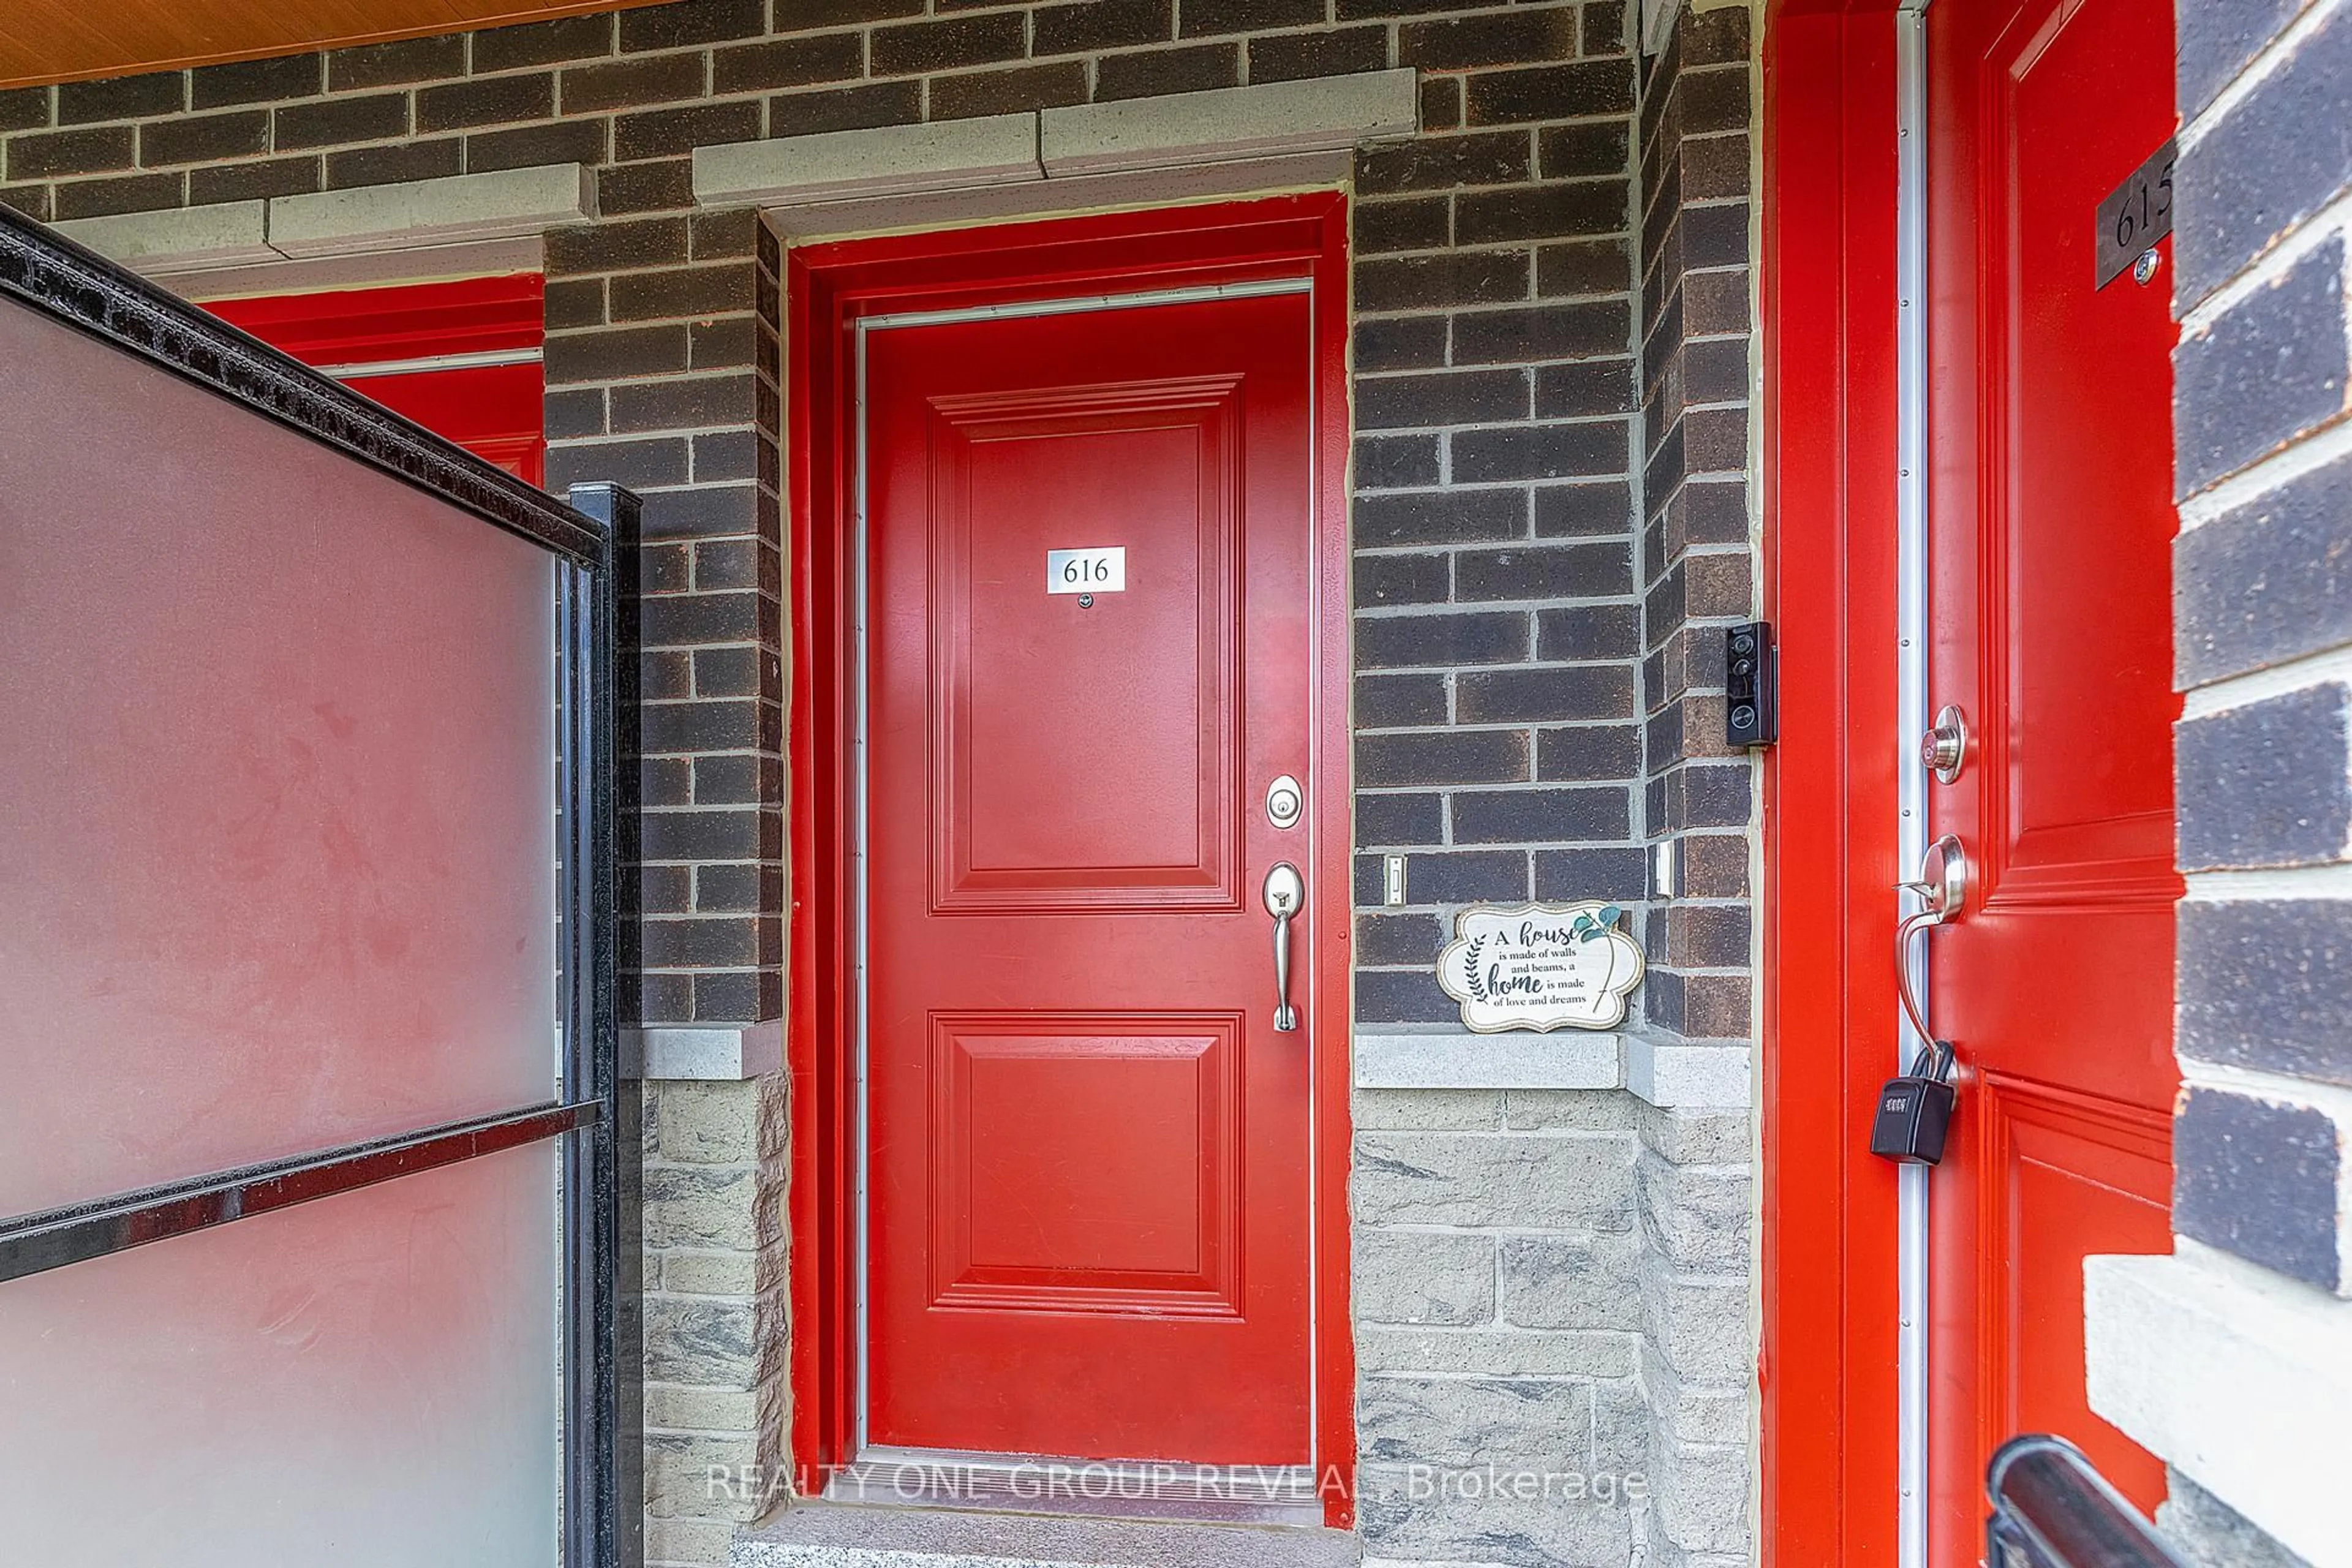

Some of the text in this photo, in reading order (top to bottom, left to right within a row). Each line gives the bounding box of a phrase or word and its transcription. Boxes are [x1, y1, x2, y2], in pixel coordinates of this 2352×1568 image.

[2117, 160, 2174, 247] 615
[1064, 558, 1108, 582] 616
[1494, 921, 1578, 948] A house
[1499, 948, 1577, 960] is made of walls
[1488, 963, 1585, 997] home is made
[1511, 963, 1529, 973] and
[1532, 963, 1566, 973] beams,
[1493, 995, 1586, 1007] of love and dreams
